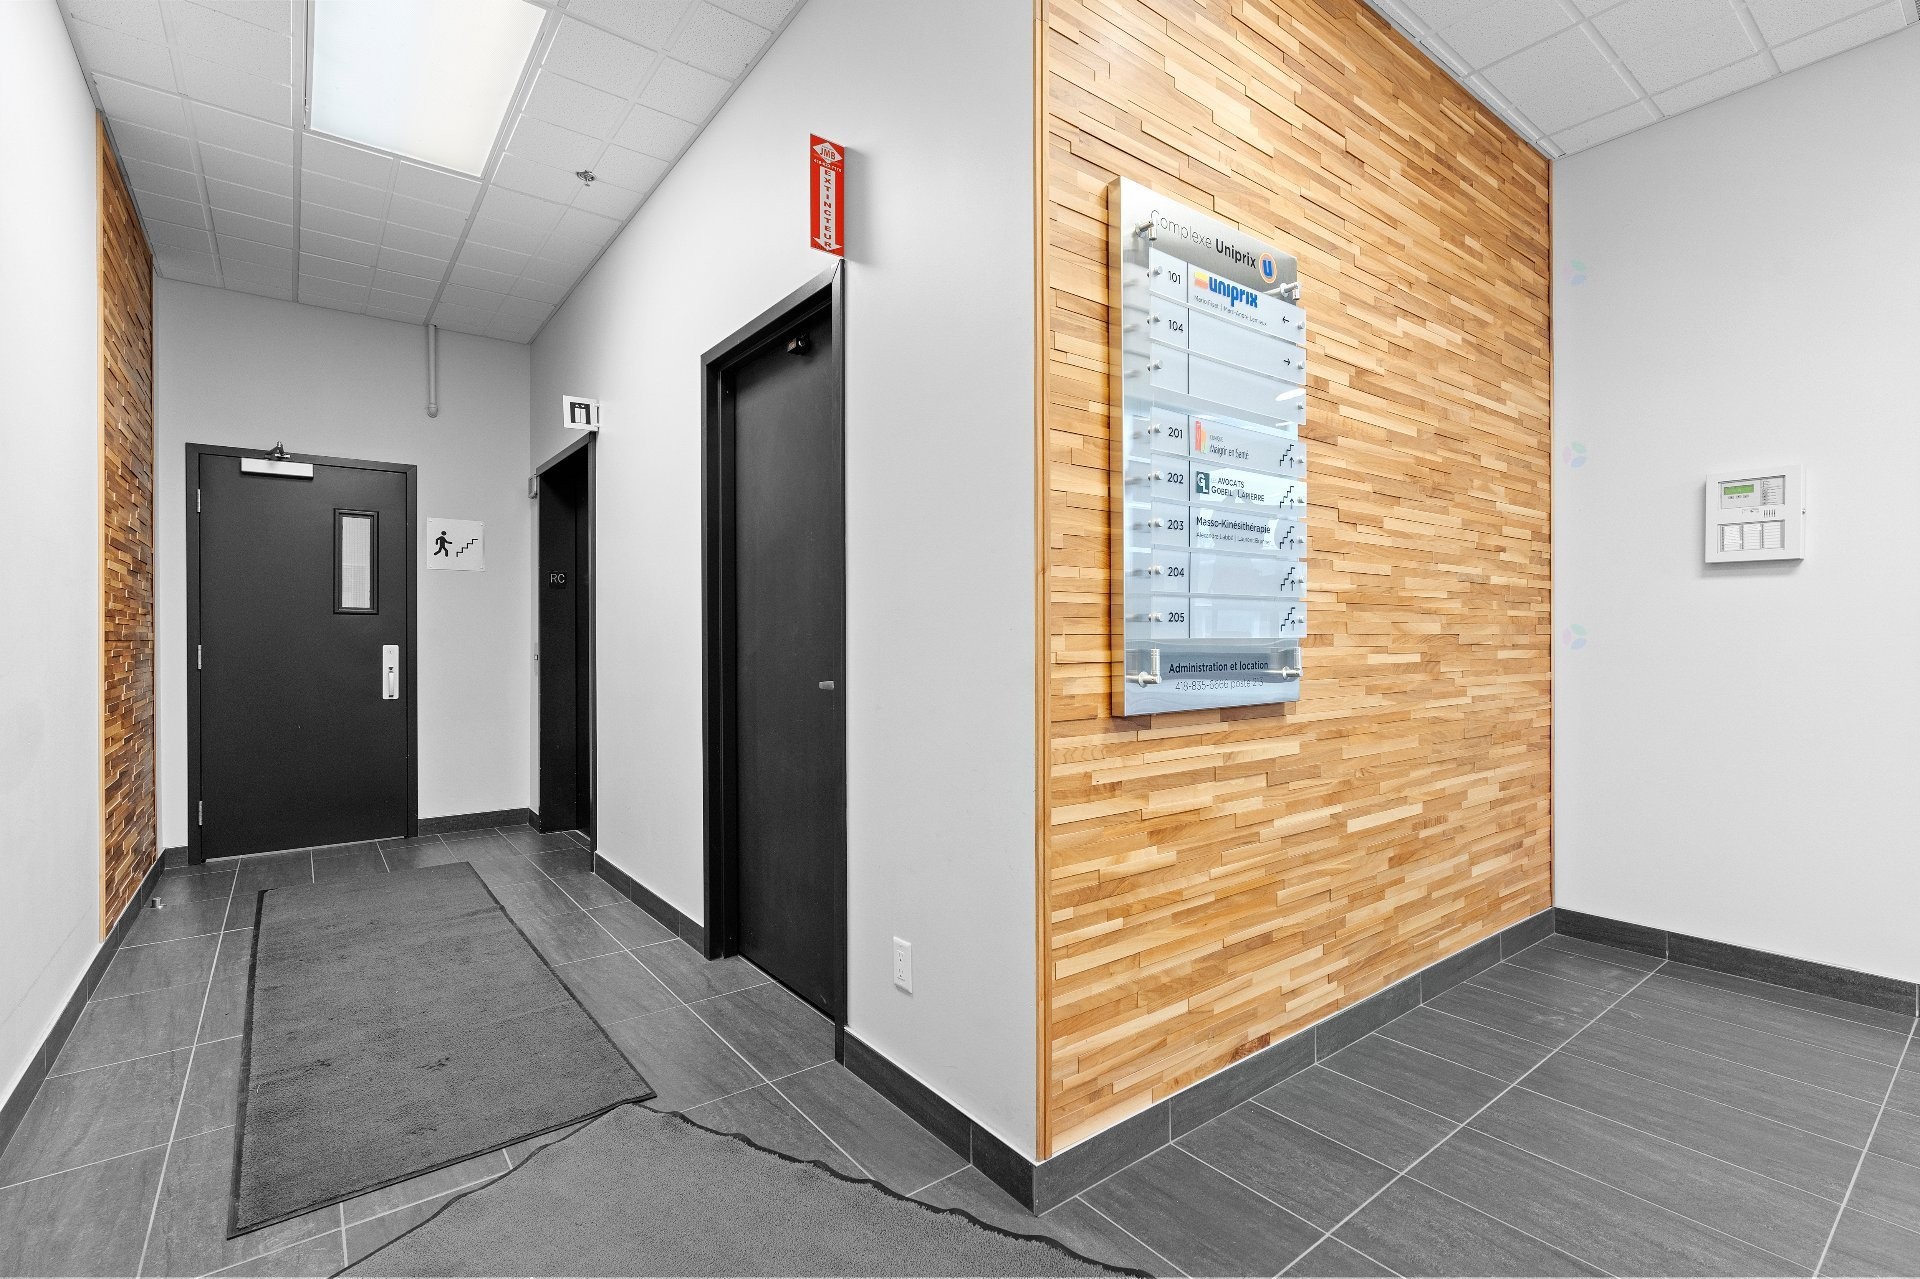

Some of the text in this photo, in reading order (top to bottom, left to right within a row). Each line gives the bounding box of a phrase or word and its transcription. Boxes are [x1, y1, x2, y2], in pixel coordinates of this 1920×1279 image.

[820, 147, 836, 160] JMB
[823, 169, 832, 249] EXTINCTEUR
[1215, 238, 1256, 269] Uniprix
[1168, 270, 1181, 285] 101
[1208, 276, 1258, 308] uniprix
[1168, 319, 1184, 332] 104
[1168, 427, 1183, 439] 201
[1167, 472, 1184, 484] 202
[1217, 477, 1245, 489] AVOCATS
[1168, 520, 1184, 531] 203
[1196, 516, 1271, 534] Masso-Kinésithérapie
[1168, 566, 1185, 577] 204
[550, 573, 565, 583] RC
[1168, 612, 1185, 623] 205
[1168, 661, 1269, 673] Administration et location
